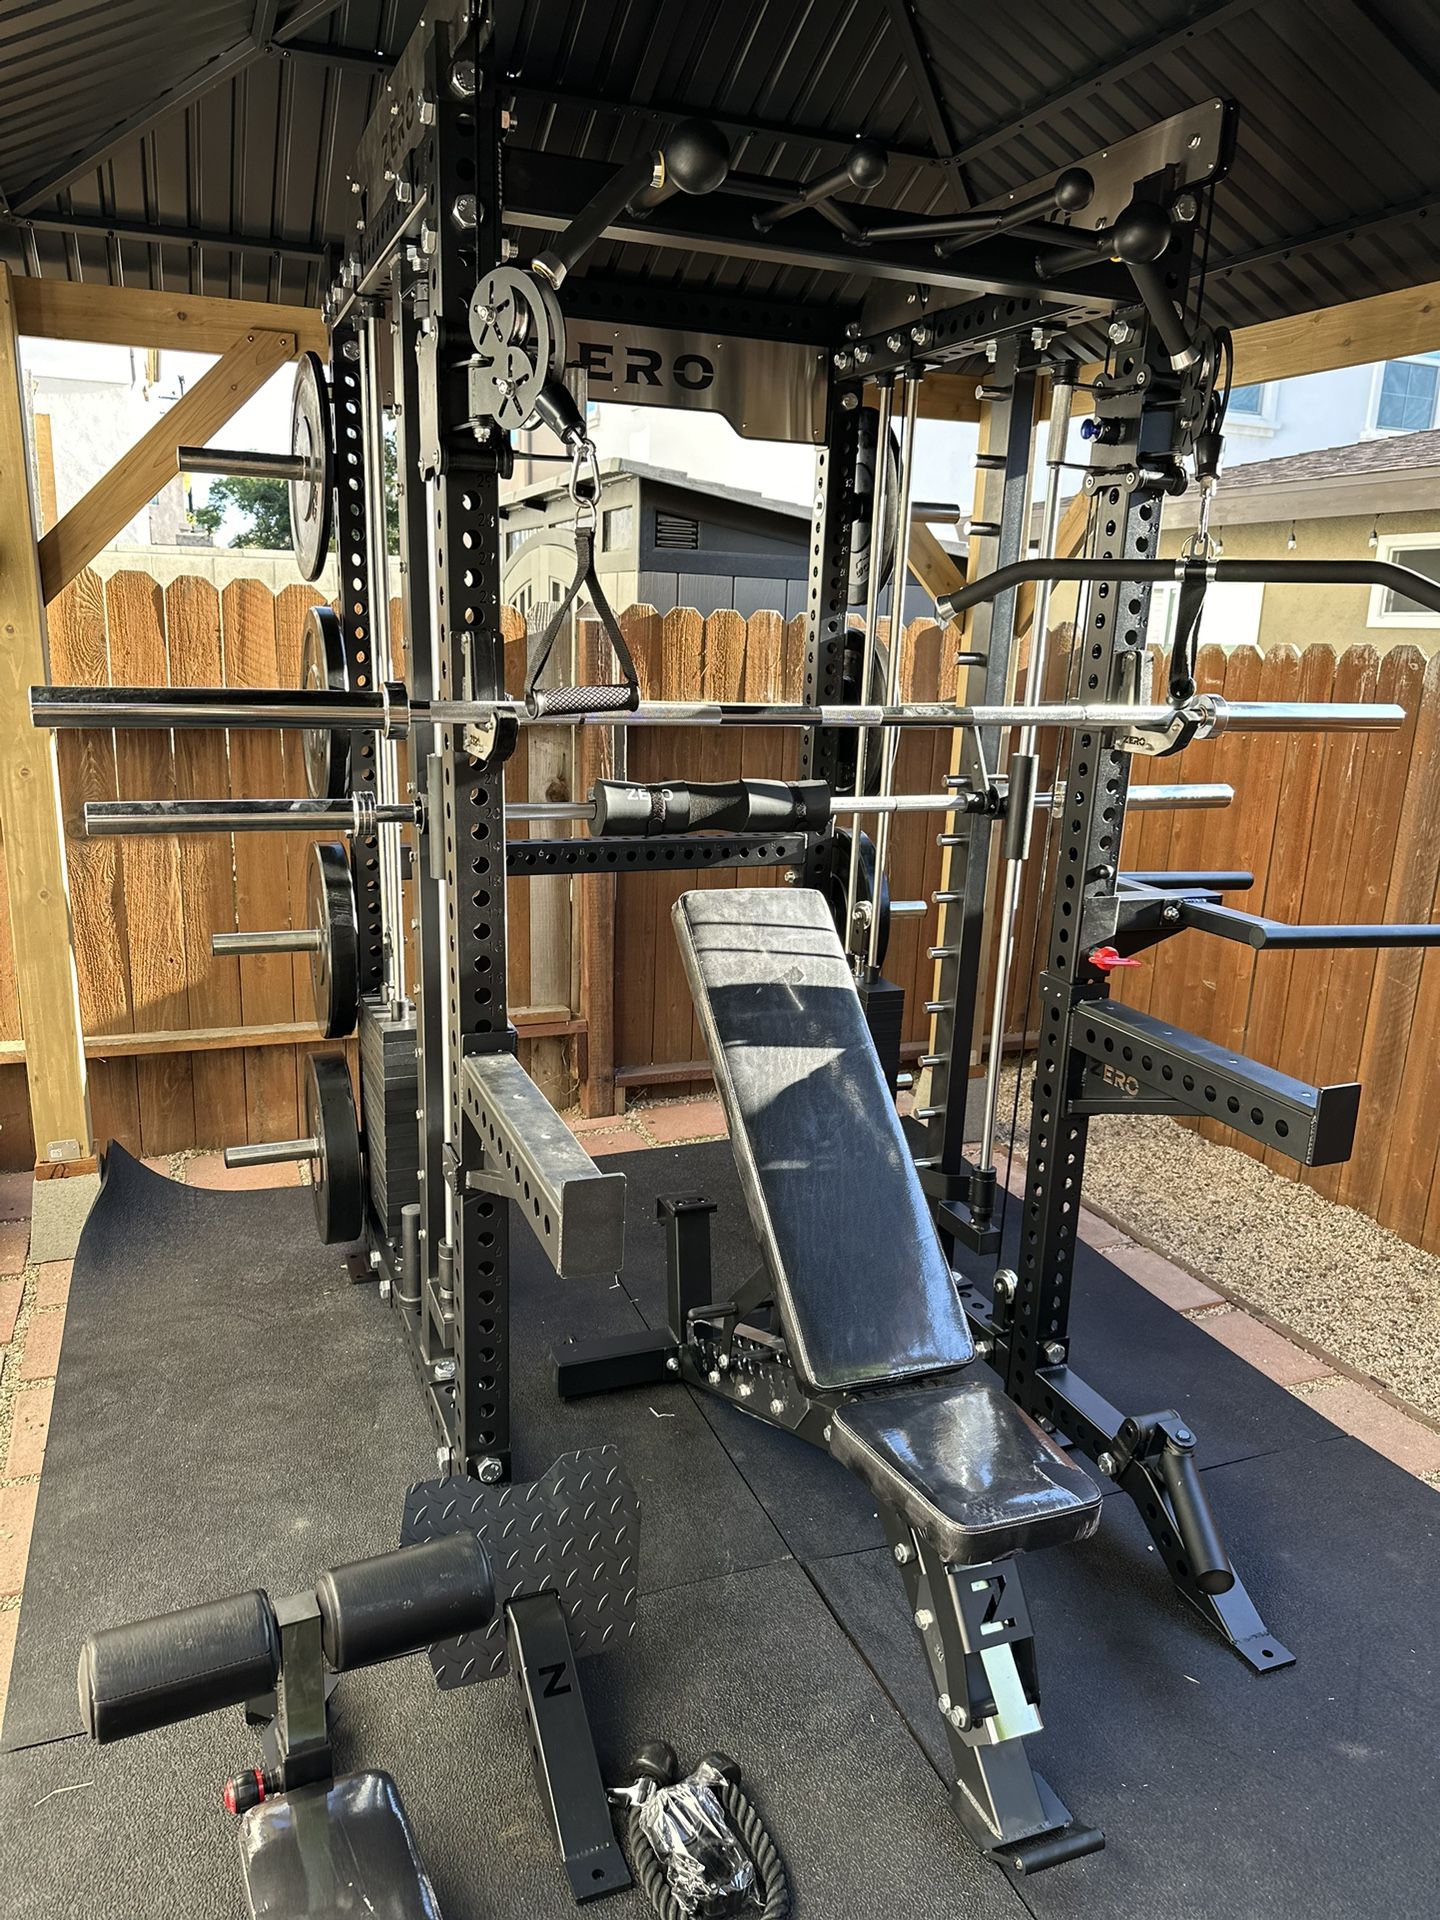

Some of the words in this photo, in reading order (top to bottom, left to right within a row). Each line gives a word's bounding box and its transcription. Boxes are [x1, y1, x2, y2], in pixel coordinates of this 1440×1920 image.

[577, 342, 714, 390] ERO
[477, 474, 493, 488] 29
[478, 513, 495, 528] 28
[478, 551, 495, 566] 27
[480, 590, 497, 605] 26
[1122, 735, 1146, 747] ZERO
[625, 788, 674, 801] ZEO
[538, 849, 545, 857] 6
[579, 847, 585, 856] 8
[599, 846, 605, 856] 9
[1089, 1058, 1139, 1096] ZERO
[494, 1275, 503, 1287] 5
[495, 1361, 503, 1372] 2
